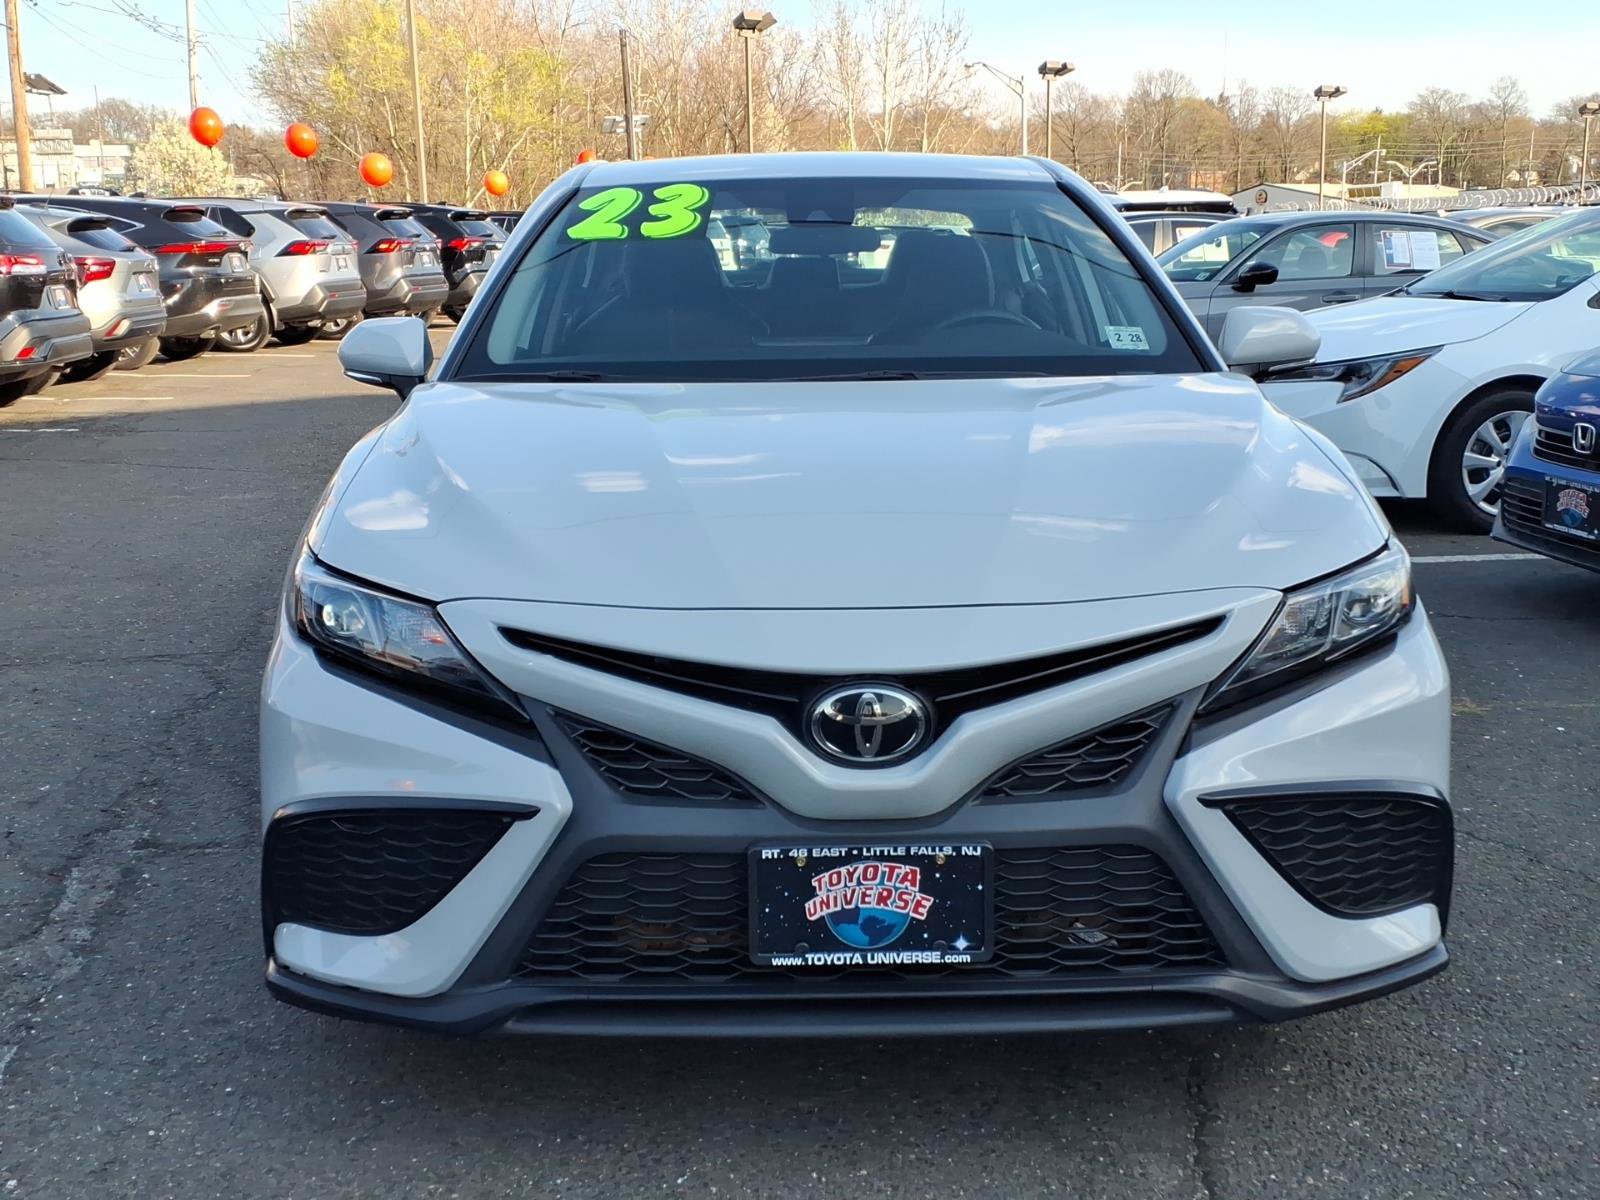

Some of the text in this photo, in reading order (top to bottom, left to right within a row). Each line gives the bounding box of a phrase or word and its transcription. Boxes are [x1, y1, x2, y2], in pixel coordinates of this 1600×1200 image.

[566, 183, 709, 240] 23
[1114, 332, 1142, 342] 2 28
[762, 847, 982, 859] RT. 46 EAST LITTLE FALLS, NJ
[812, 863, 921, 893] TOYOTA
[805, 885, 934, 920] UNIVERSE
